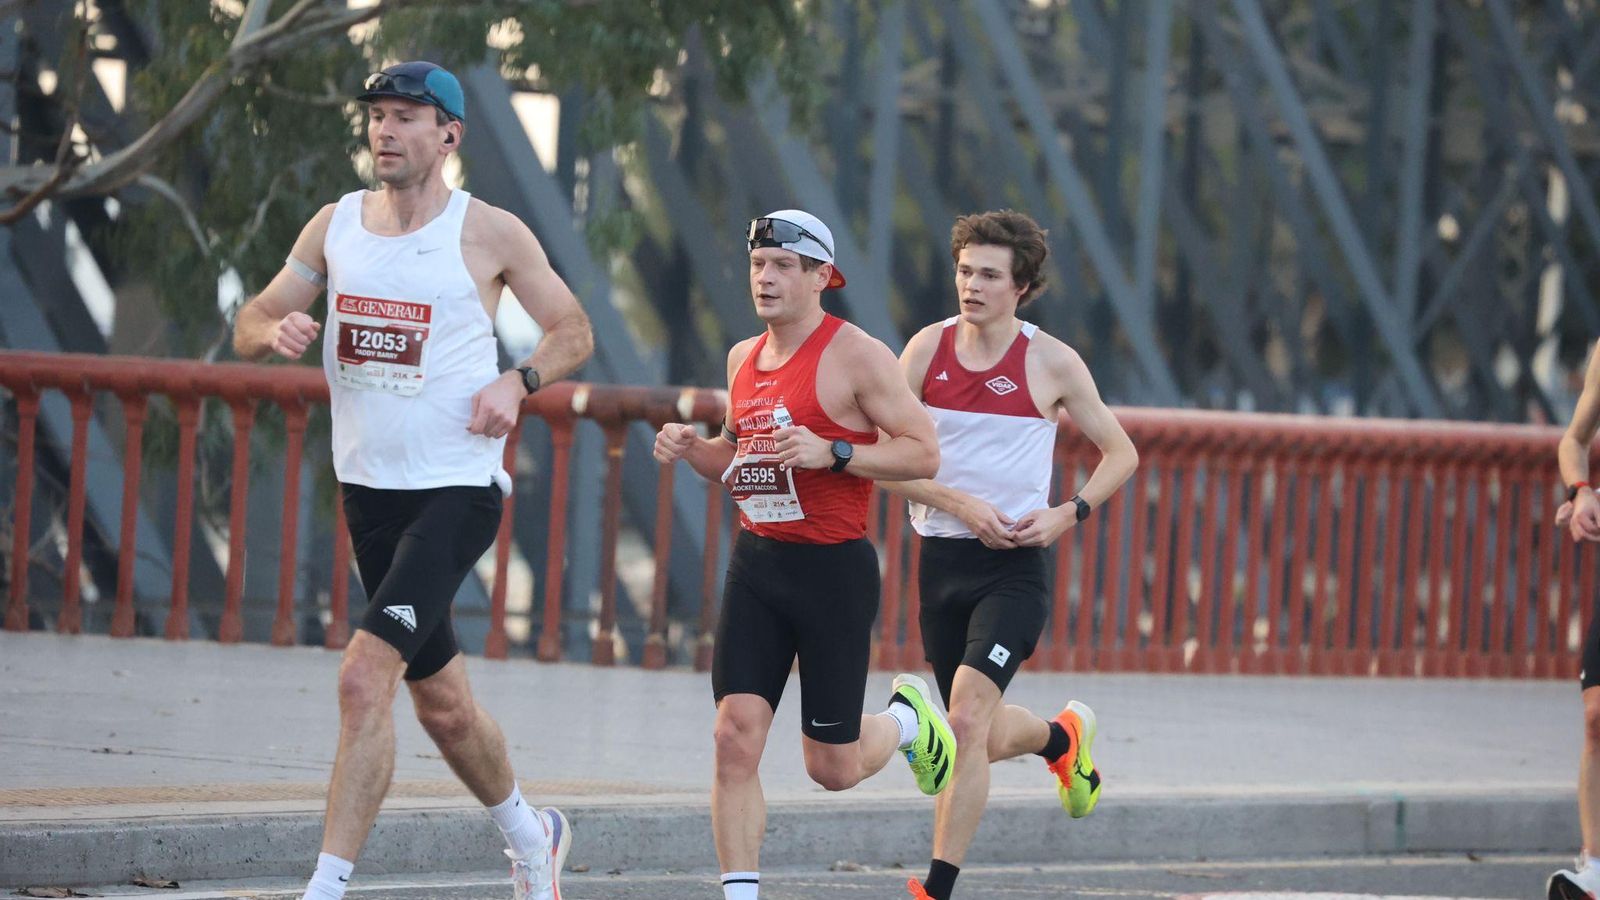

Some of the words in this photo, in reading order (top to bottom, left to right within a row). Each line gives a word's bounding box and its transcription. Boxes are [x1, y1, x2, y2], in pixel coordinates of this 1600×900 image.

[358, 300, 425, 320] GENERALI
[350, 328, 408, 352] 12053
[354, 348, 376, 356] PADDY
[376, 350, 399, 359] BARRY
[382, 608, 400, 620] NIKE
